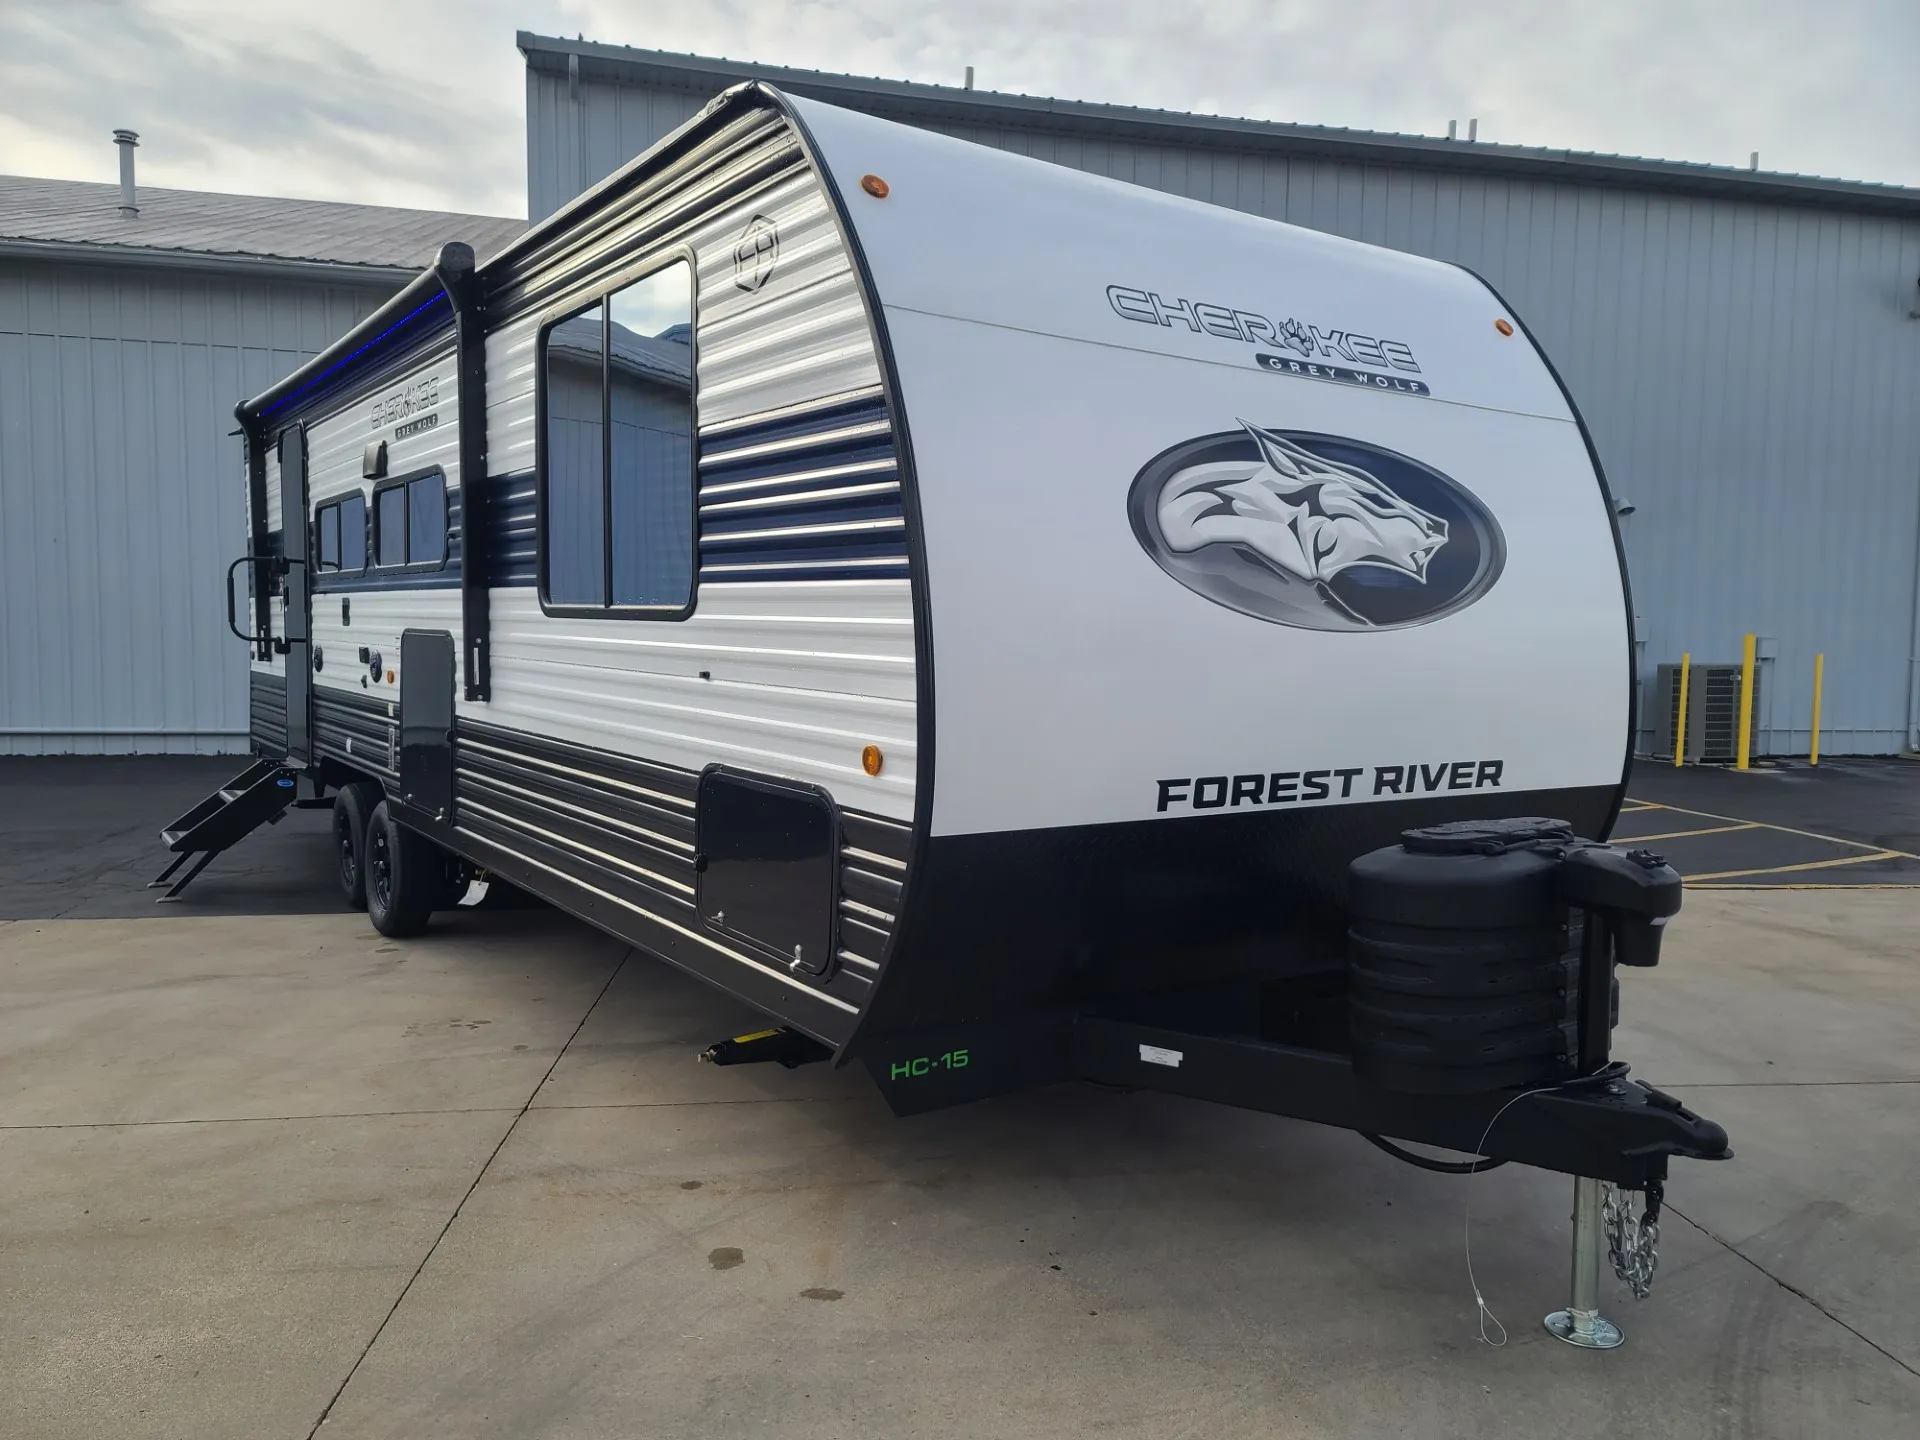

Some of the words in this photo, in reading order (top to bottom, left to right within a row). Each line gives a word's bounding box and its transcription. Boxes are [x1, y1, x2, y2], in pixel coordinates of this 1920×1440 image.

[1269, 358, 1336, 379] GREY
[1353, 372, 1420, 392] WOLF
[397, 425, 414, 438] GREY
[417, 416, 436, 432] WOLF
[1156, 768, 1363, 812] FOREST
[1373, 759, 1504, 796] RIVER
